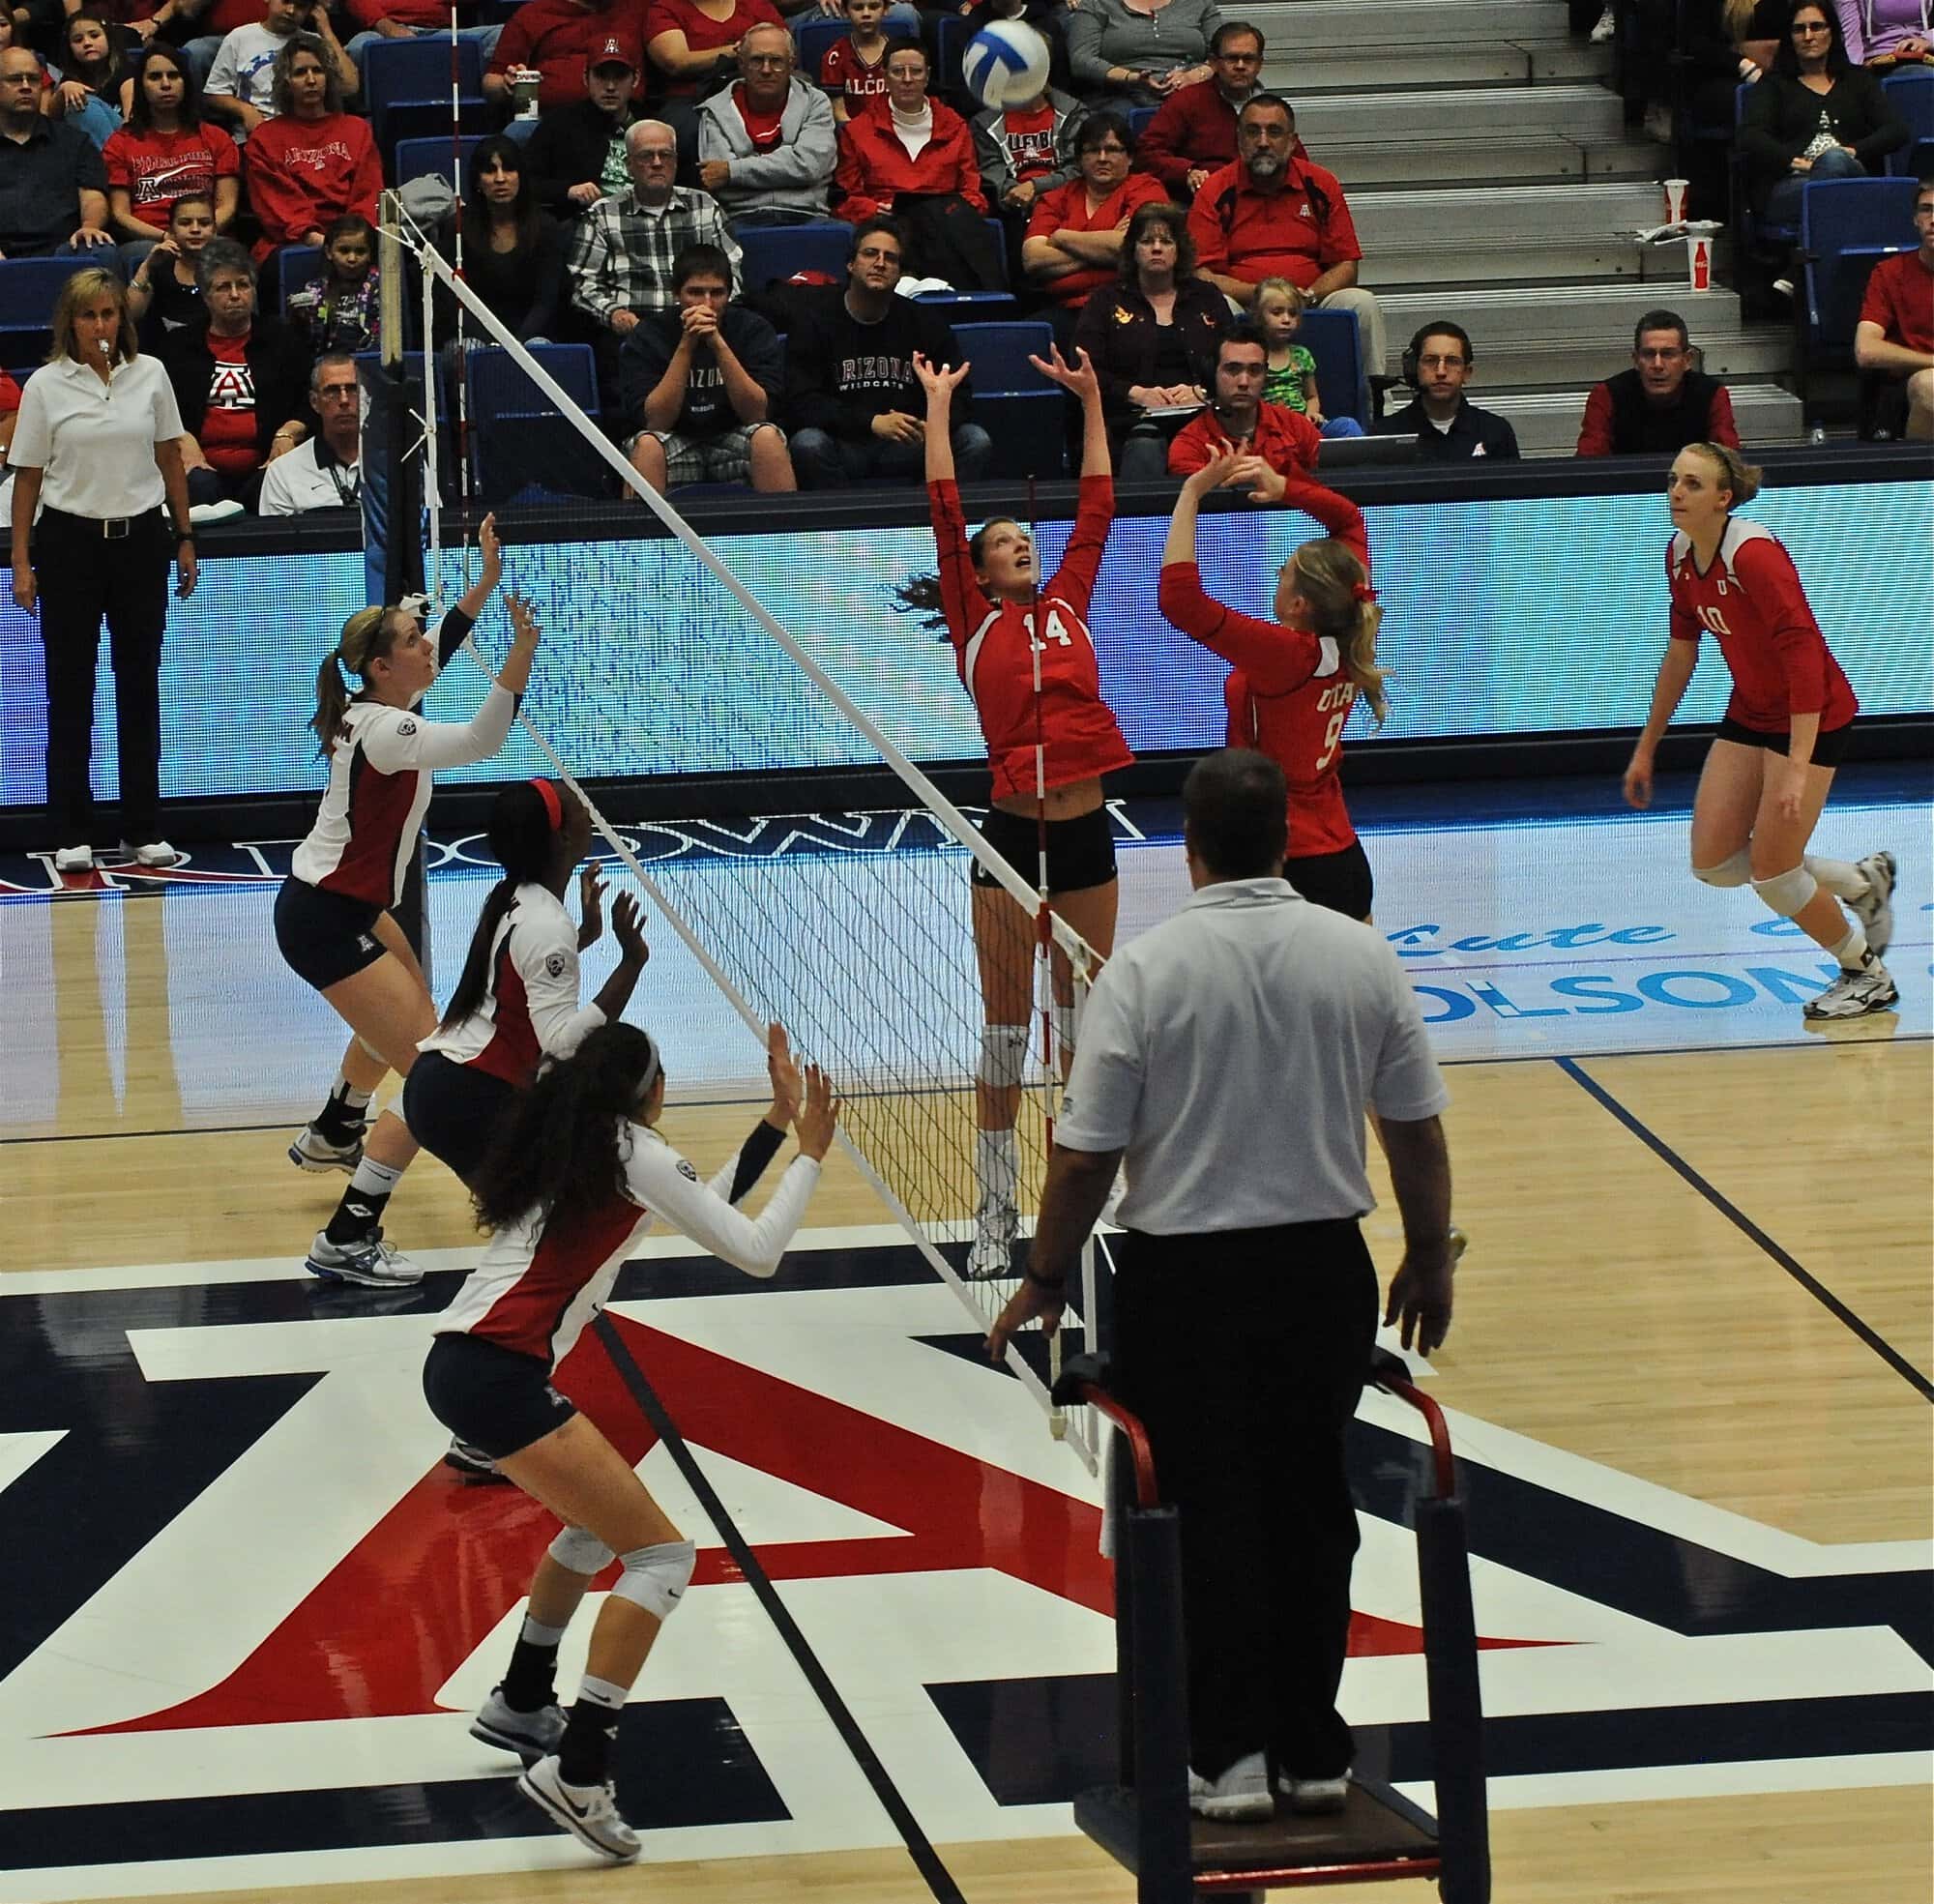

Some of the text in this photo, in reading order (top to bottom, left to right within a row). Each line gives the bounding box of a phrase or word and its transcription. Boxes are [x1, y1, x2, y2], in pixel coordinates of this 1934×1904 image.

[828, 51, 839, 66] C
[845, 78, 890, 95] ALCO
[835, 356, 914, 384] RIZONA
[1716, 579, 1728, 596] U
[1023, 609, 1072, 652] 14
[1697, 604, 1732, 635] 10
[1316, 683, 1355, 713] UTA
[1316, 712, 1344, 771] 9
